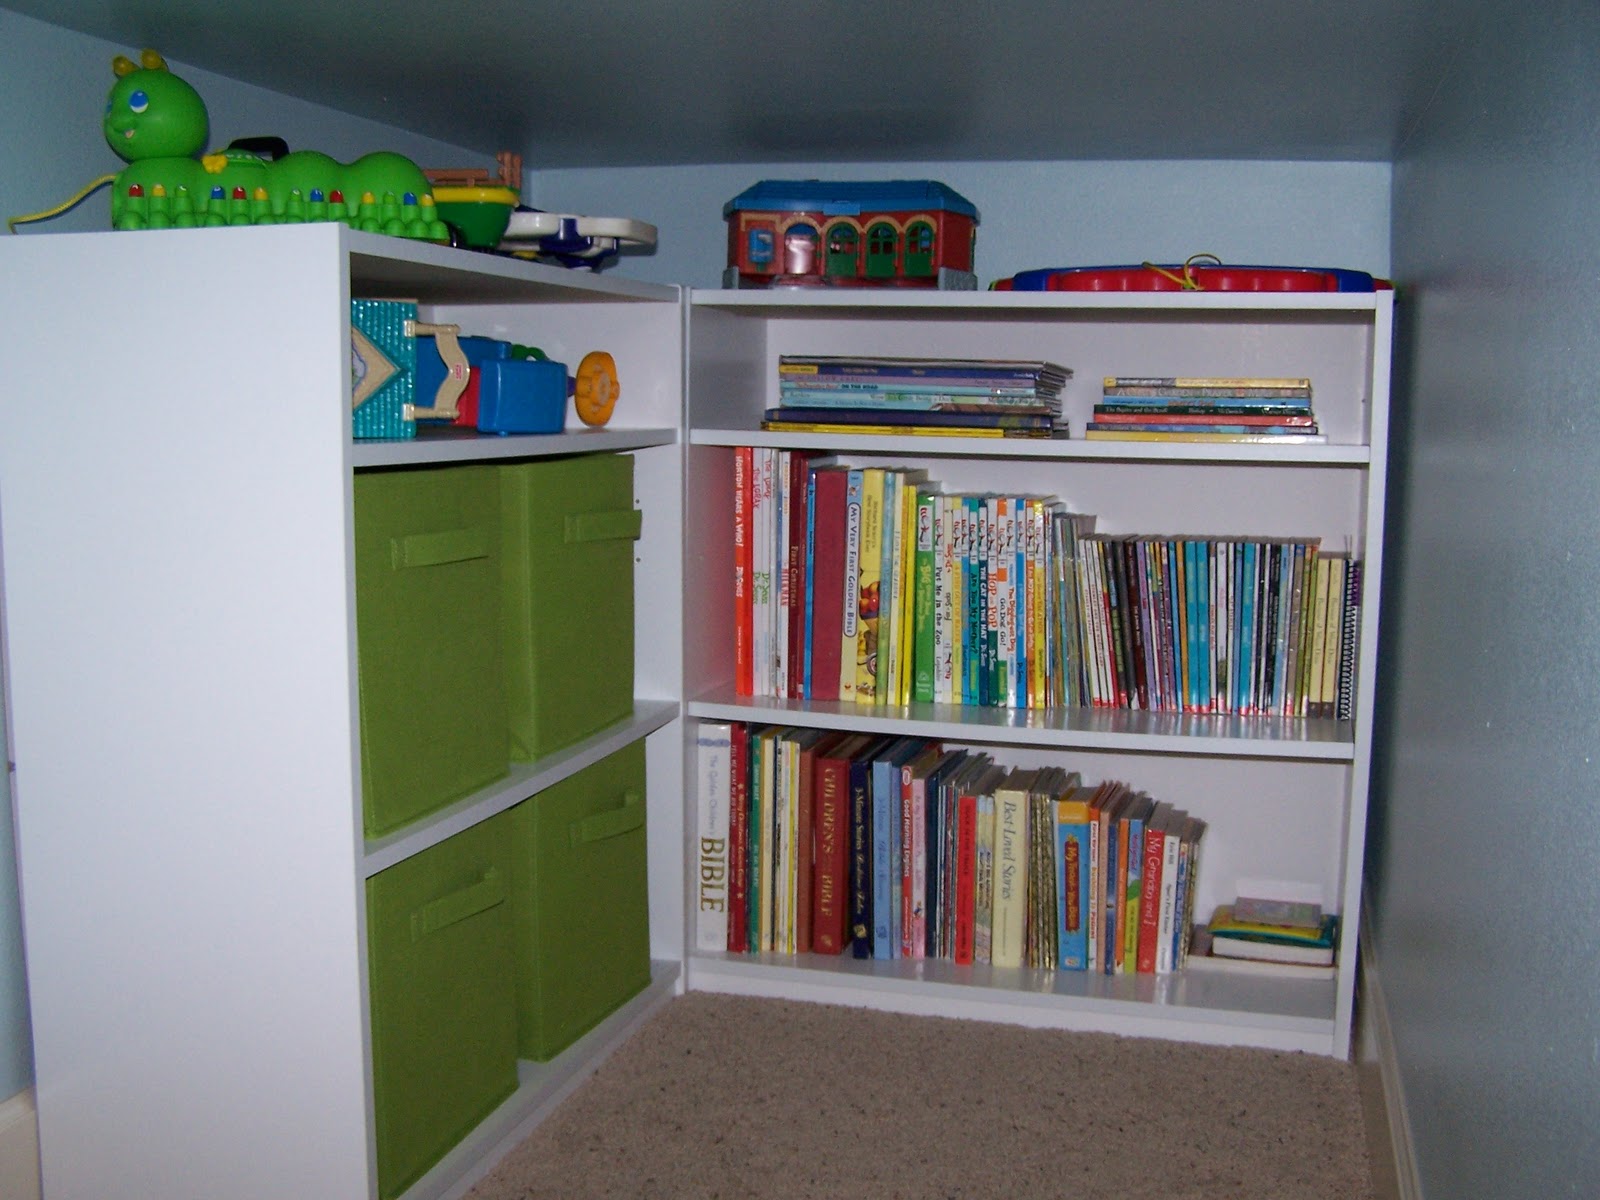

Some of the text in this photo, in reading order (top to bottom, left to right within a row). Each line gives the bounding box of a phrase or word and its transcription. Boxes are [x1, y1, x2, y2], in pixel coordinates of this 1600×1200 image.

[735, 456, 744, 488] HORTON
[735, 490, 744, 513] HEARS
[753, 483, 762, 511] LORAX
[735, 524, 744, 547] WHO!
[846, 507, 857, 634] MY VERY FIRST GOLDEN BIBLE
[936, 585, 943, 596] Me
[980, 599, 986, 607] IN
[988, 573, 998, 628] HOP POP
[969, 571, 979, 655] Are You My Mother?
[1007, 638, 1016, 652] Dog
[821, 768, 837, 917] CHILDREN'S BIBLE
[855, 824, 865, 850] Stories
[902, 799, 911, 878] Good Morning Engines
[1147, 836, 1161, 854] My
[1066, 846, 1078, 860] My
[700, 836, 726, 913] BIBLE
[1002, 864, 1017, 900] Stories
[1145, 901, 1153, 918] and
